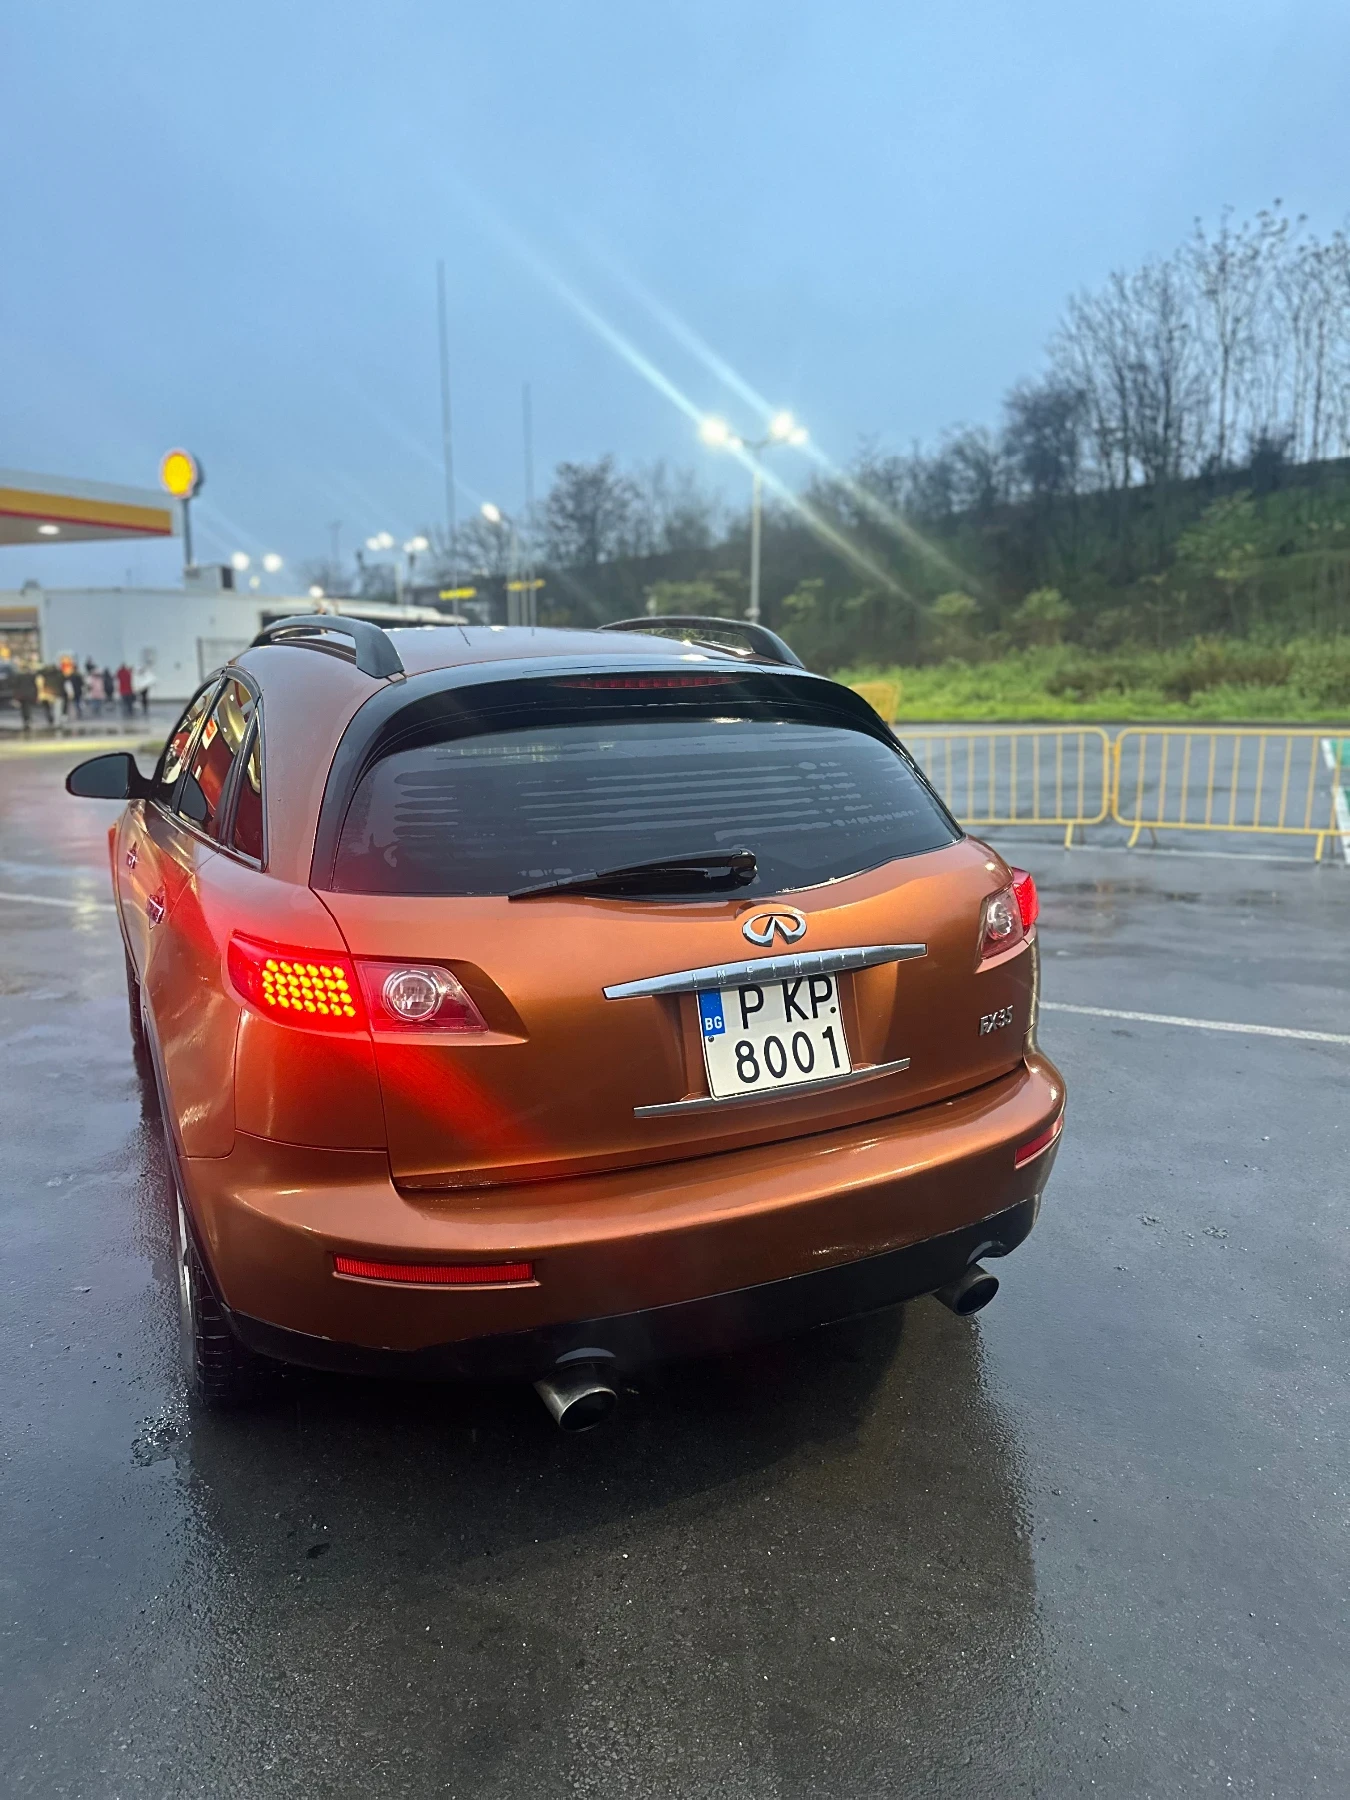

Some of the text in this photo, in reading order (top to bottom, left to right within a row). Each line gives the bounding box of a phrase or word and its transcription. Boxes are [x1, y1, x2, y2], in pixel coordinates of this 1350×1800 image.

[704, 1015, 723, 1031] BG
[738, 974, 833, 1029] P KP
[979, 1004, 1014, 1036] FX35
[735, 1026, 840, 1084] 8001
